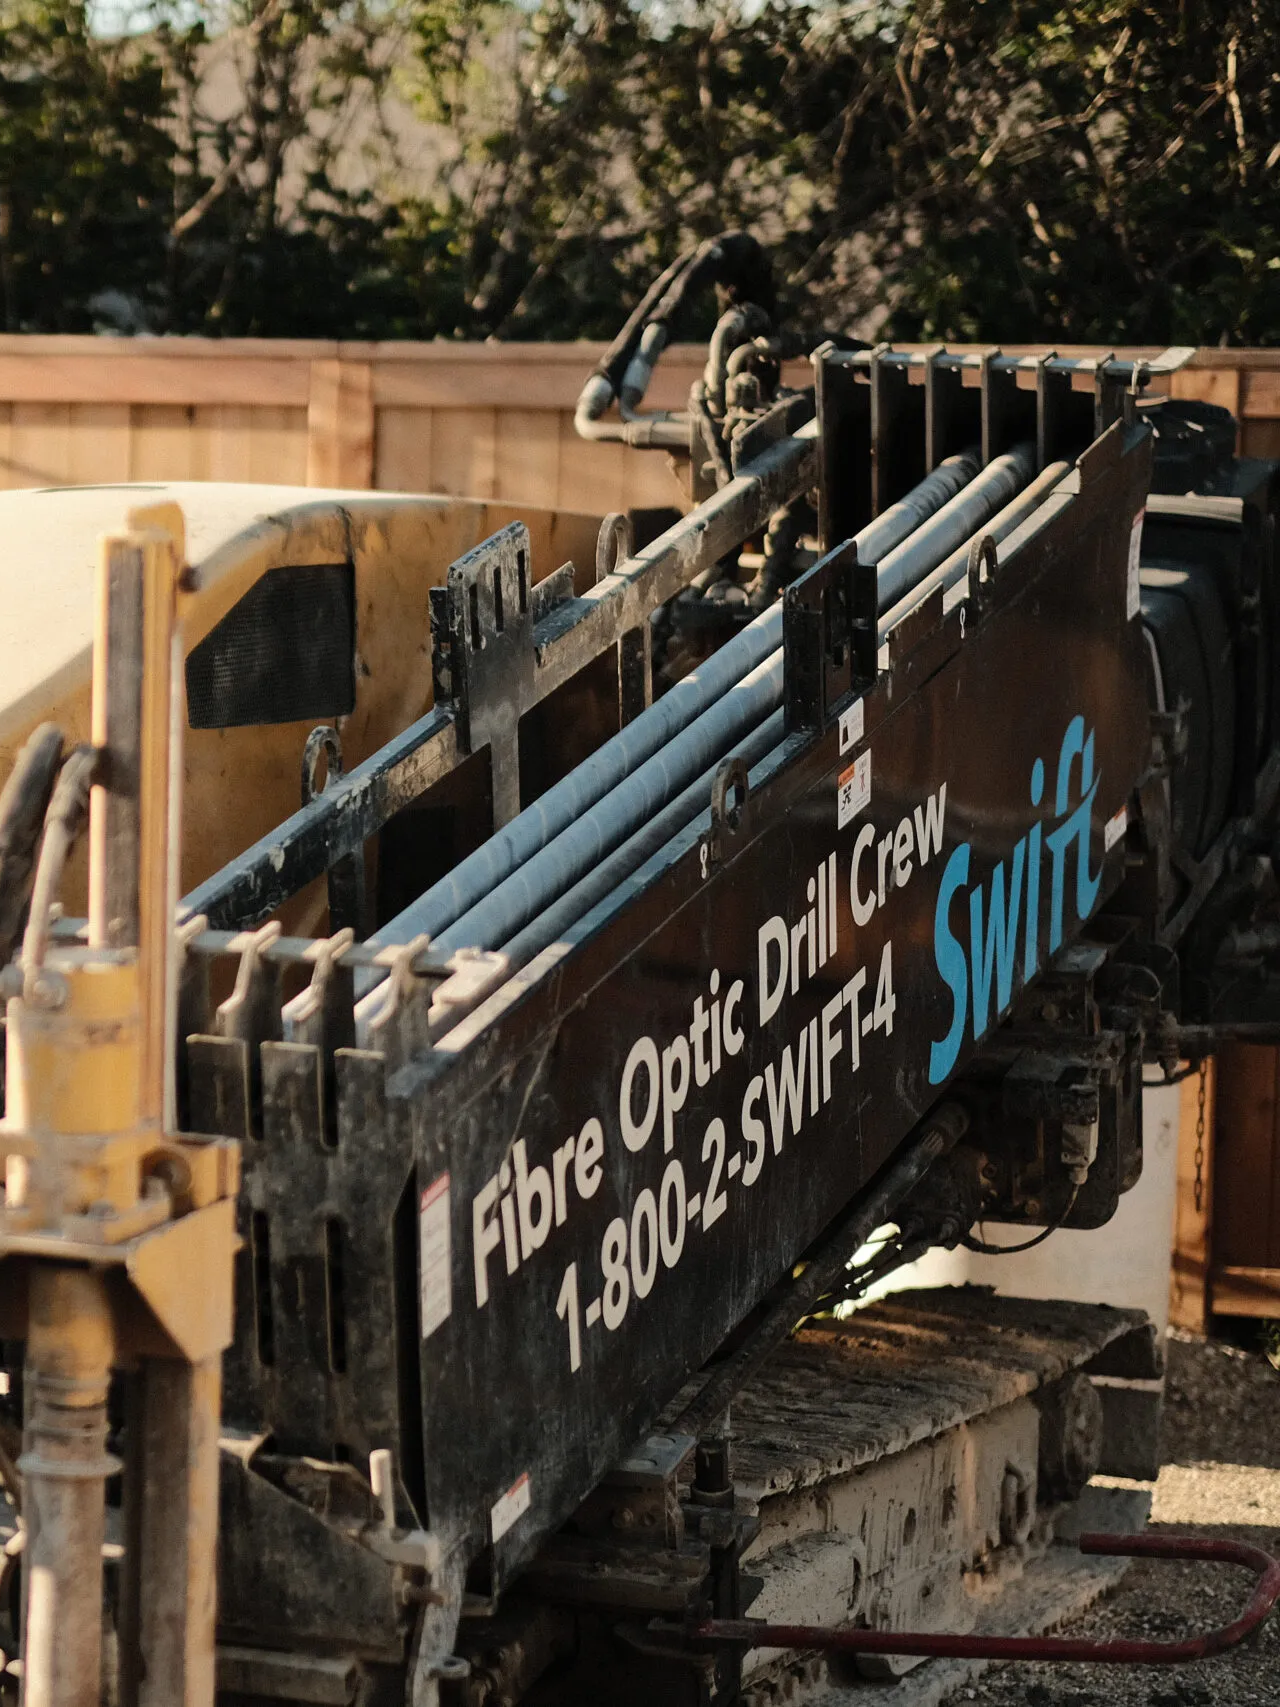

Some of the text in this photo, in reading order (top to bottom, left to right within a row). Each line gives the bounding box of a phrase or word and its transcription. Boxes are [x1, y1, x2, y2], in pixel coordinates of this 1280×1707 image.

[472, 1117, 603, 1309] Fibre
[620, 968, 744, 1155] Optic
[757, 852, 837, 1028] Drill
[849, 781, 947, 927] Crew
[929, 715, 1104, 1085] Swift
[555, 940, 896, 1373] 1-800-2-SWIFT-4
